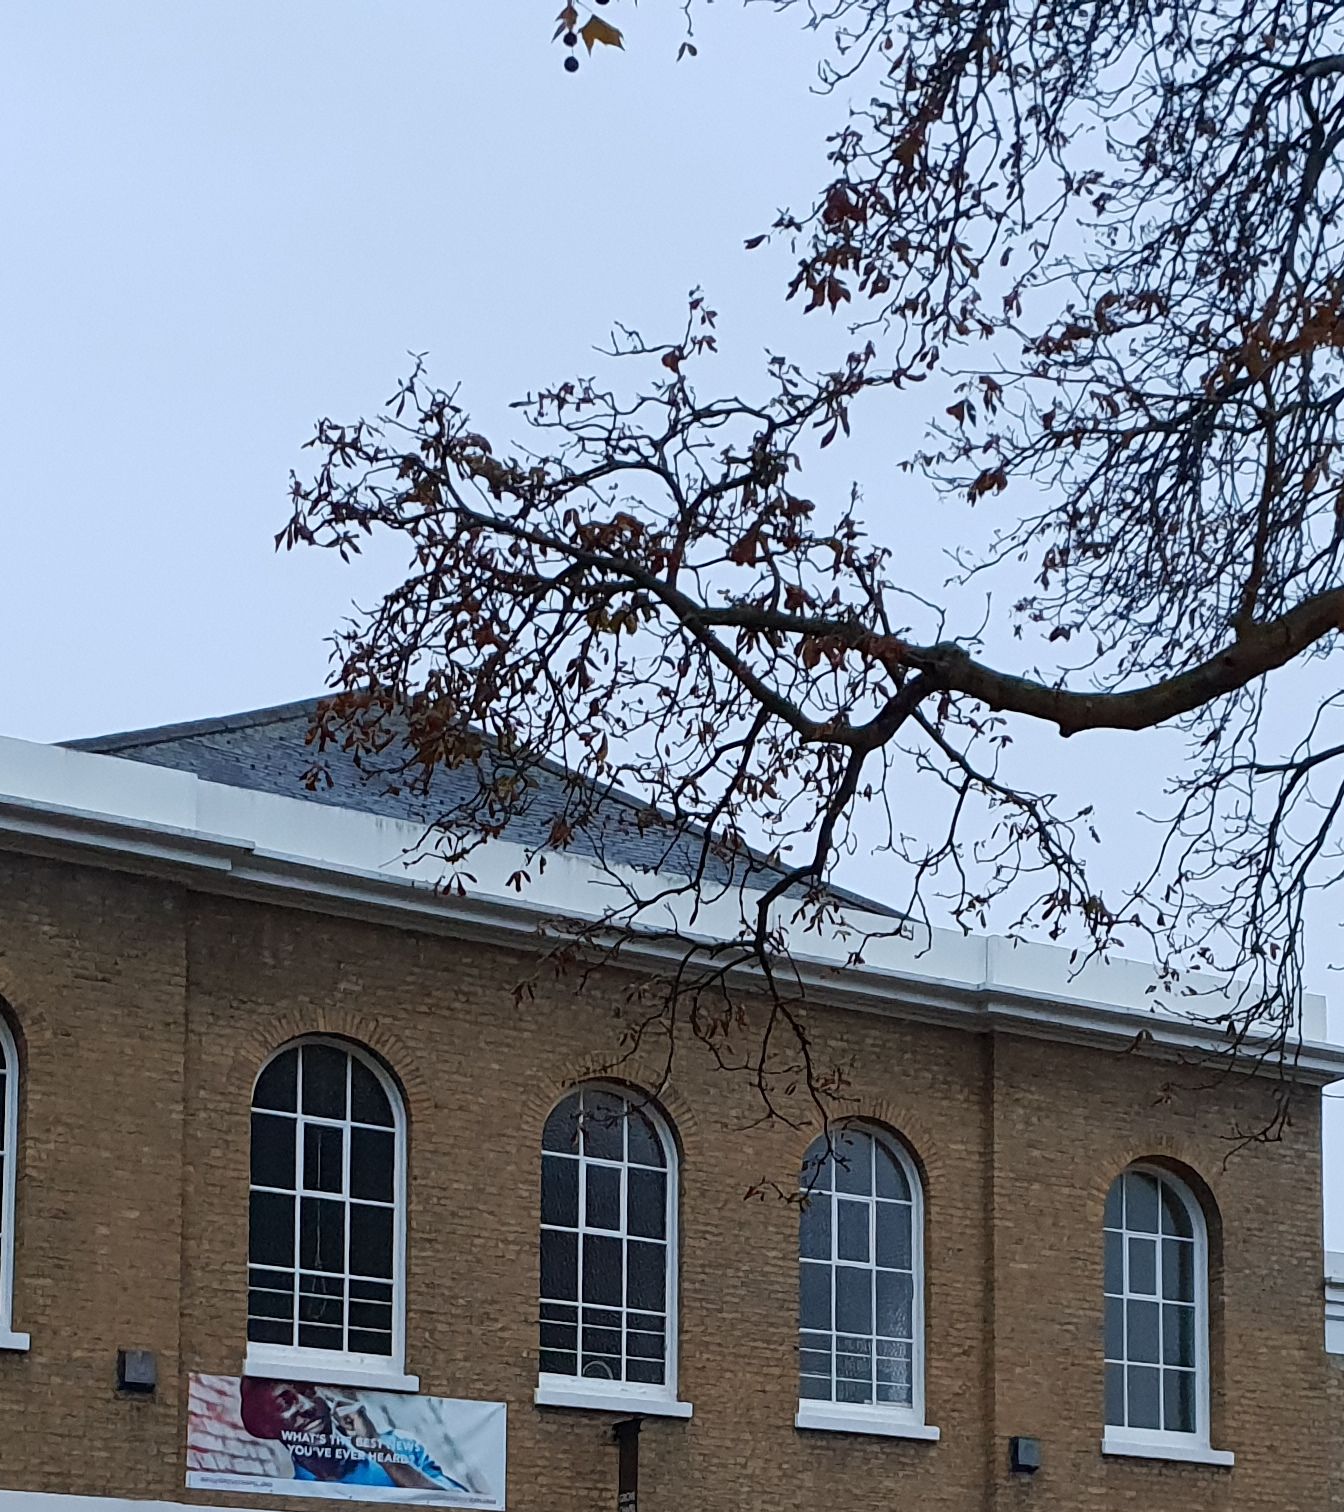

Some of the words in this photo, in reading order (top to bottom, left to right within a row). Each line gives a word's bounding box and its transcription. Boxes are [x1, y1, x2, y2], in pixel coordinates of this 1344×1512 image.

[281, 1430, 326, 1444] WHAT'S
[356, 1437, 382, 1449] BEST
[287, 1444, 332, 1458] YOU'VE
[335, 1448, 366, 1461] EVER
